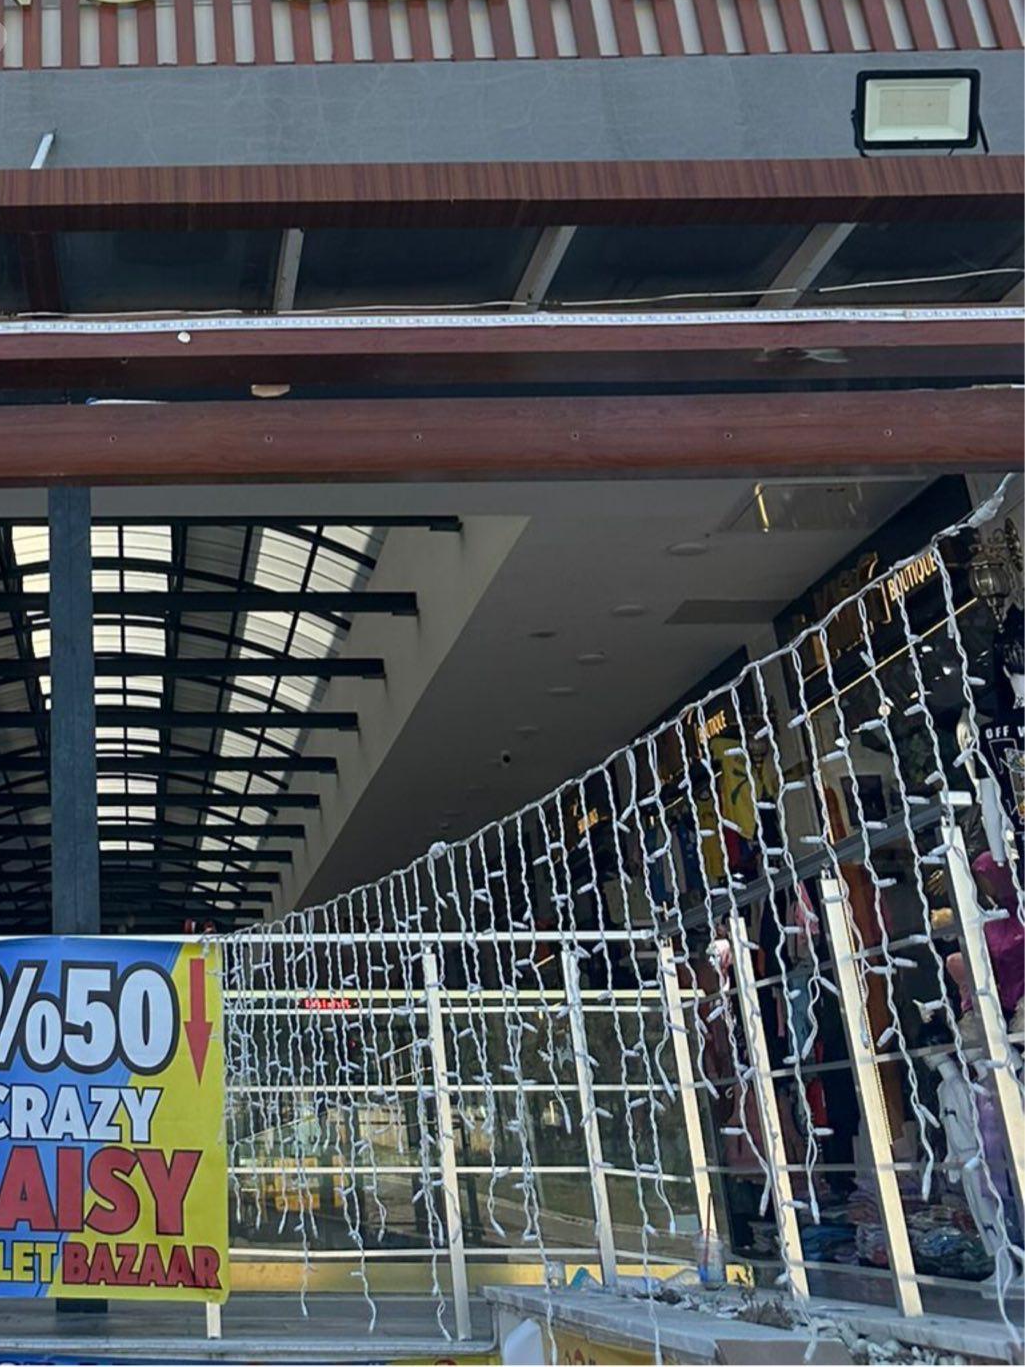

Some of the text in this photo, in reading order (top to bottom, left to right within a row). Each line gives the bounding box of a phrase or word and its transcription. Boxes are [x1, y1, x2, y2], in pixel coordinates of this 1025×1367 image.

[887, 553, 937, 601] BOUTIQUE
[985, 725, 1010, 740] OFF
[61, 1242, 222, 1289] BAZAAR
